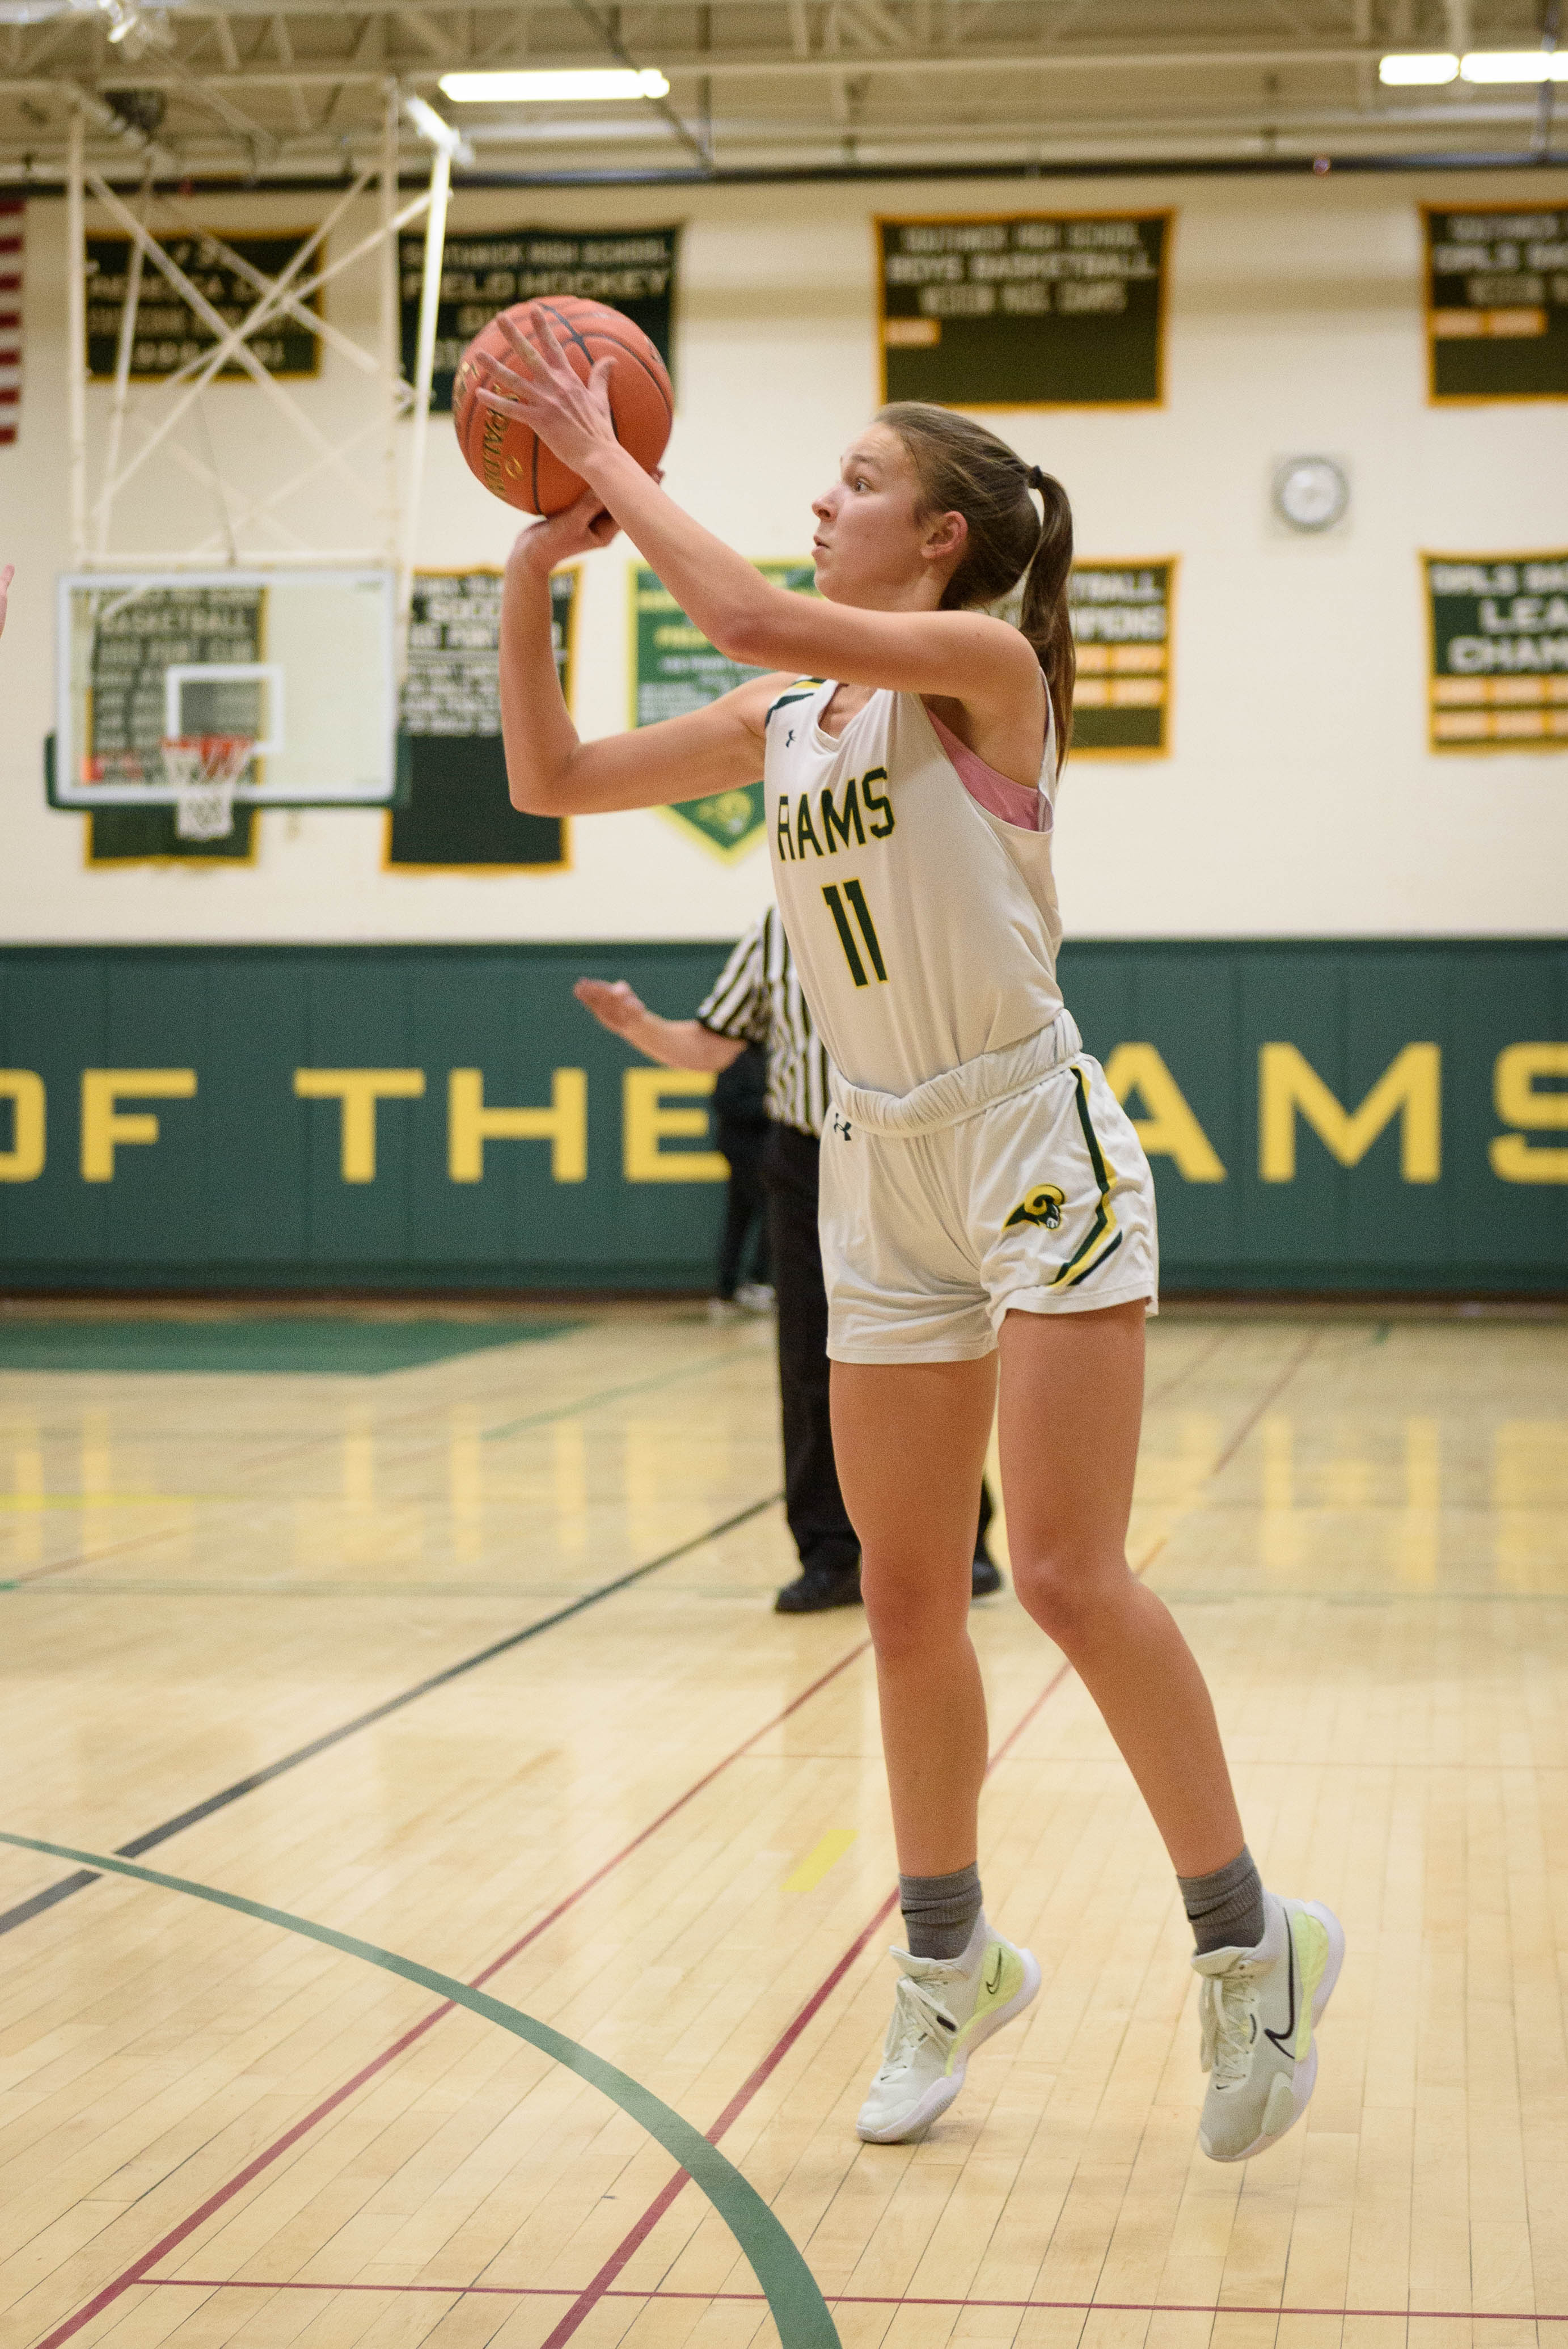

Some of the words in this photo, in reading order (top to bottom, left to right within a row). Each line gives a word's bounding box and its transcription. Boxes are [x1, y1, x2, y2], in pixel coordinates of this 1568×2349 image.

[404, 243, 522, 265] STHWICK
[404, 271, 514, 301] FELD
[519, 269, 669, 295] HOCKEY
[887, 255, 963, 281] BOYS
[969, 252, 1157, 279] BASKETBALL
[777, 766, 895, 861] RAMS
[821, 876, 889, 990] 11
[293, 1068, 732, 1184] THE
[1106, 1041, 1568, 1185] AMS
